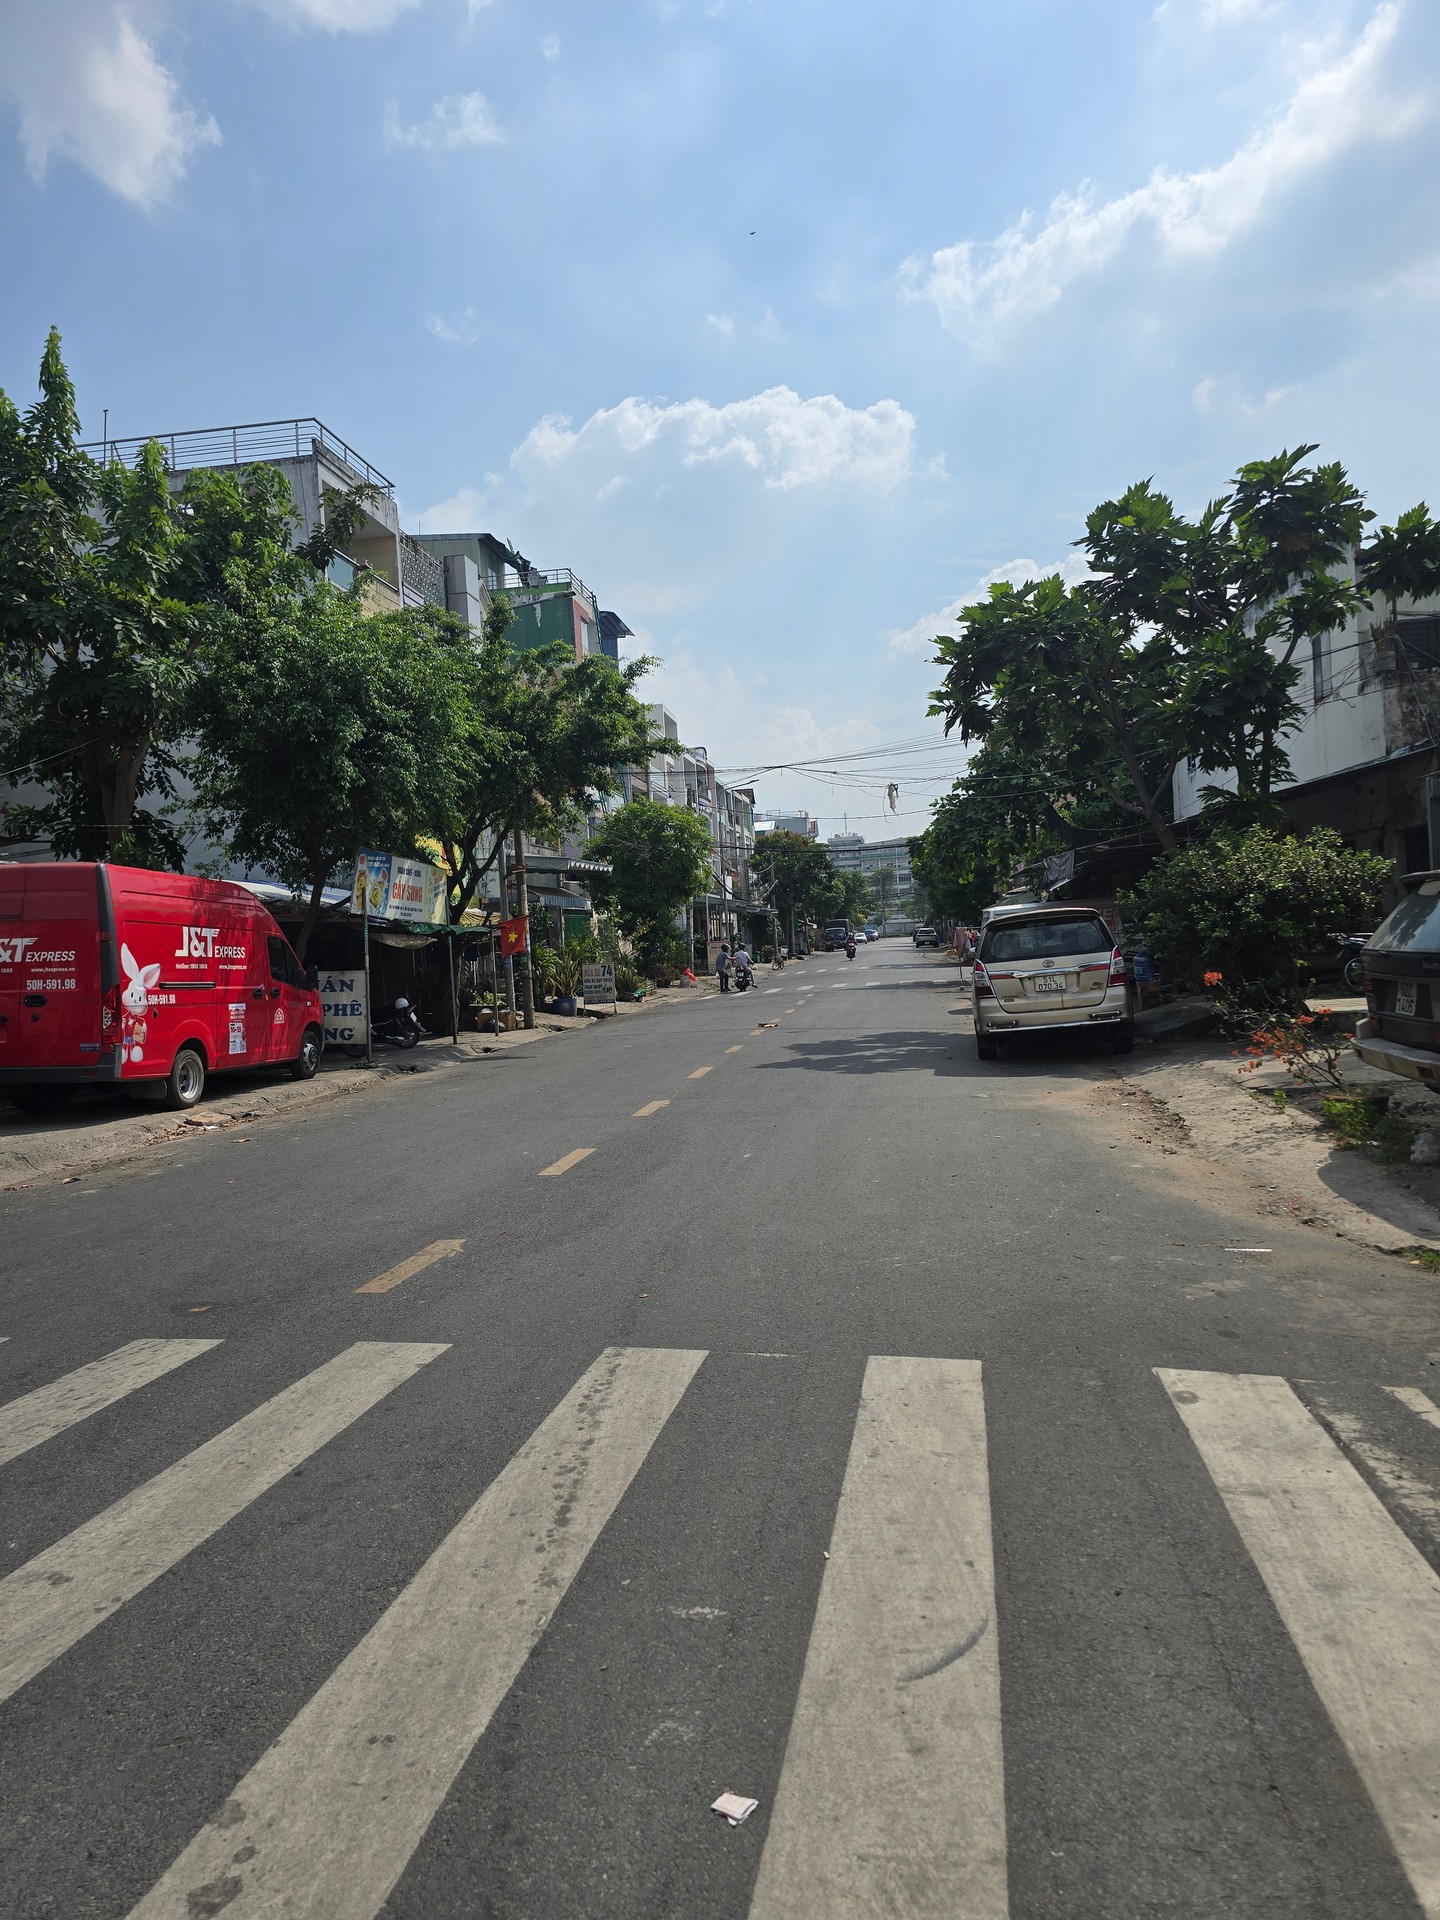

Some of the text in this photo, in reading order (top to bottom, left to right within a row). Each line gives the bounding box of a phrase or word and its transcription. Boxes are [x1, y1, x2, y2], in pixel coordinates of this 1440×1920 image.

[174, 926, 246, 958] J&T EXPRESS
[26, 950, 76, 962] EXPRESS
[601, 965, 613, 976] 74
[26, 978, 76, 990] 50H-591.98
[322, 999, 362, 1016] PHÊ
[324, 1027, 354, 1041] NG
